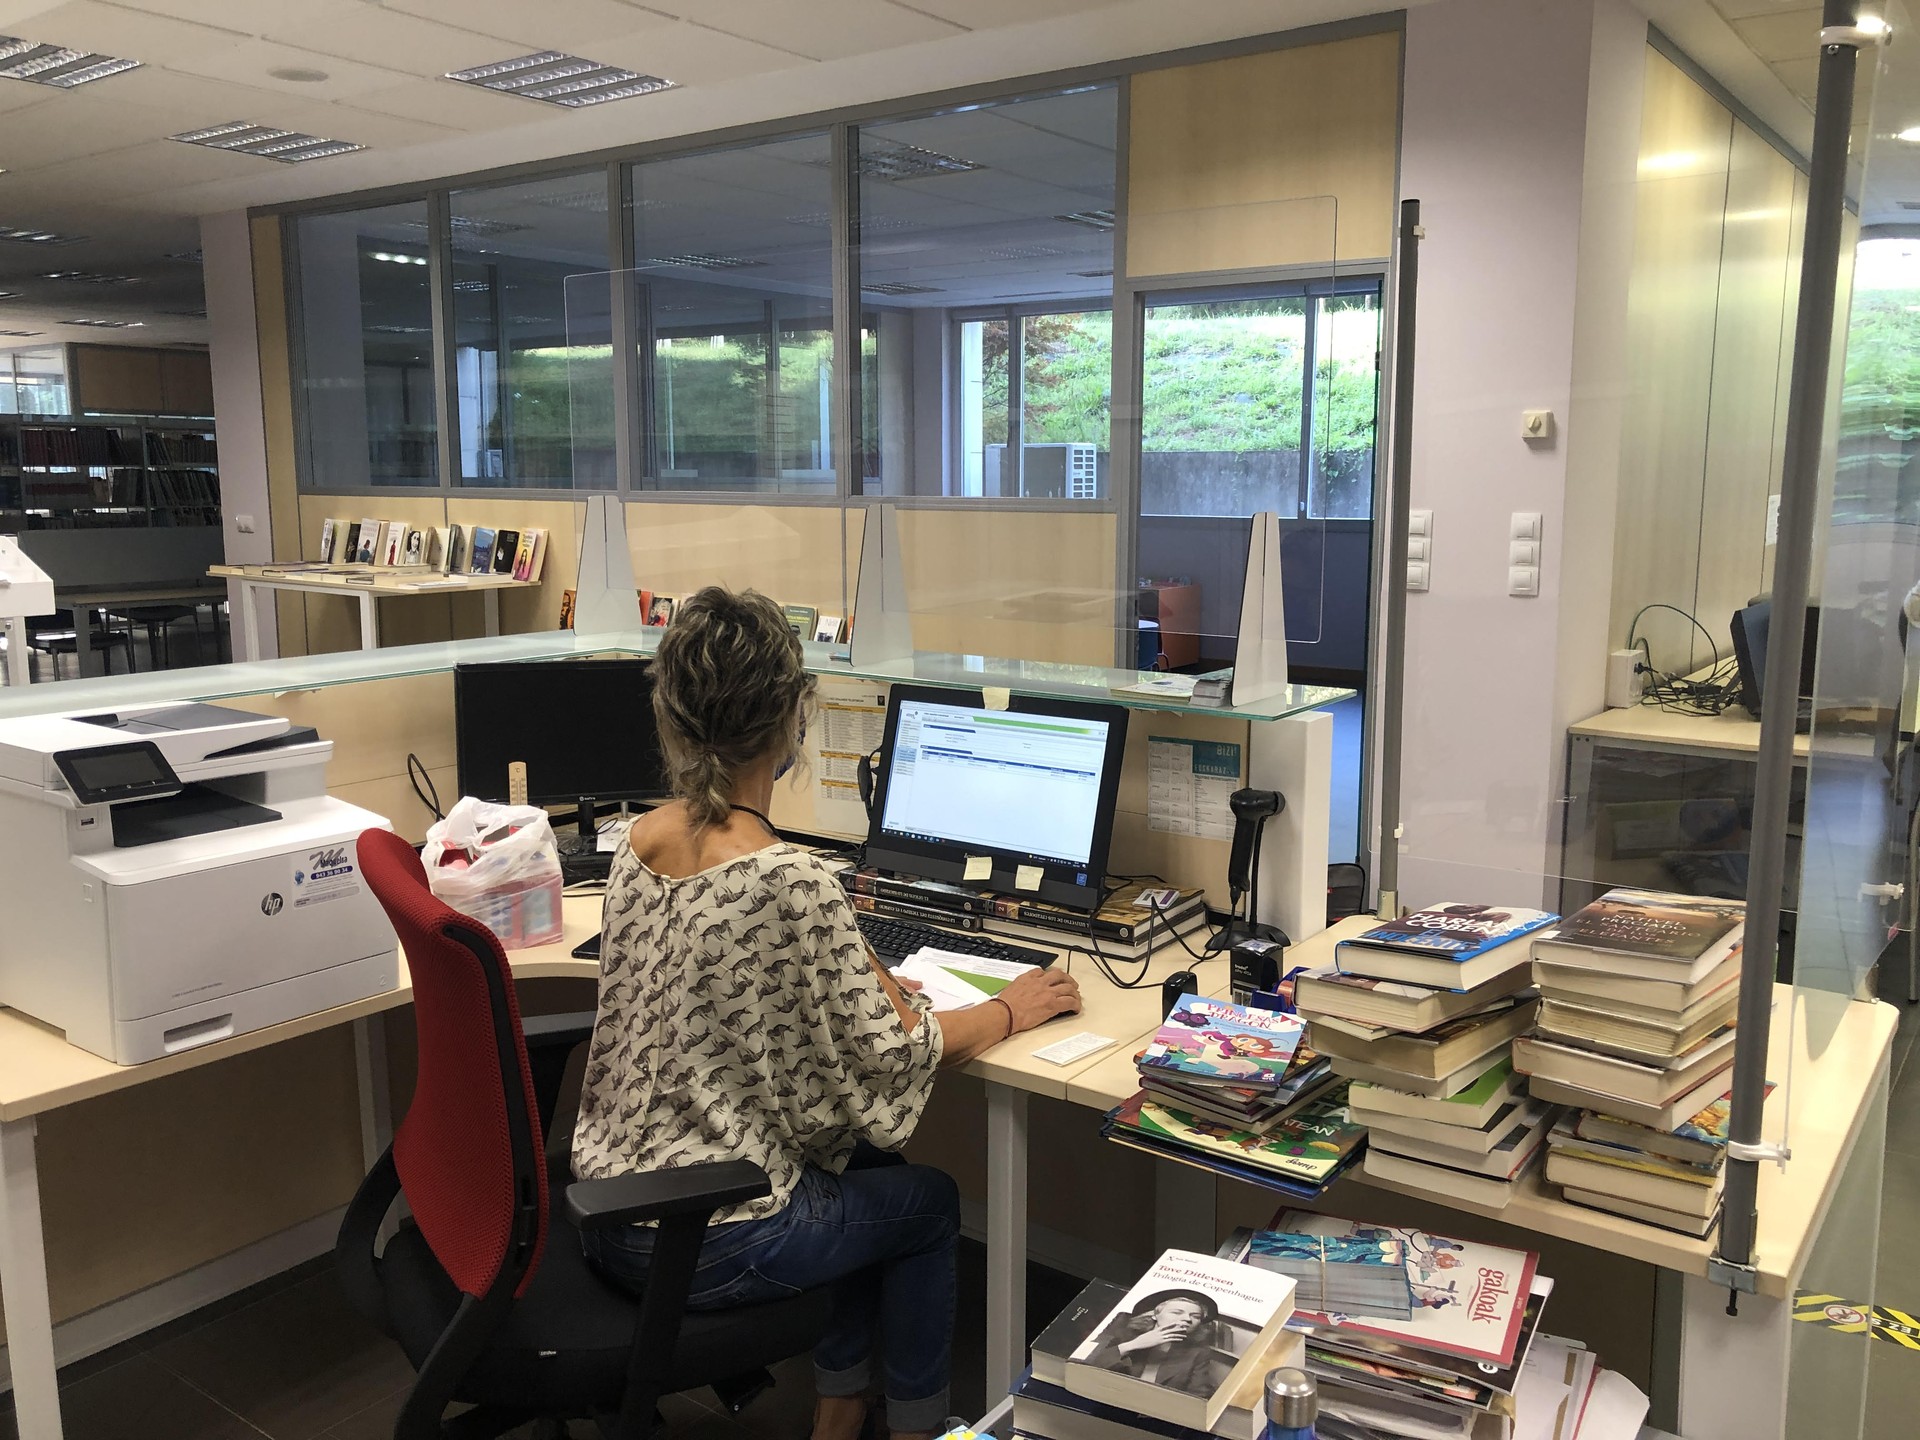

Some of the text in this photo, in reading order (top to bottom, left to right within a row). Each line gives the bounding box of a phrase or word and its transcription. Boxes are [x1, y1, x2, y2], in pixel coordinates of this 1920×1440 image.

[262, 892, 284, 917] hp
[1405, 920, 1496, 936] COBEN
[1601, 916, 1687, 931] PRECIADO
[1158, 1264, 1234, 1287] Tove Ditlevsen
[1189, 1278, 1201, 1286] de
[1202, 1282, 1264, 1304] Copenhague
[1471, 1267, 1509, 1325] gakoak
